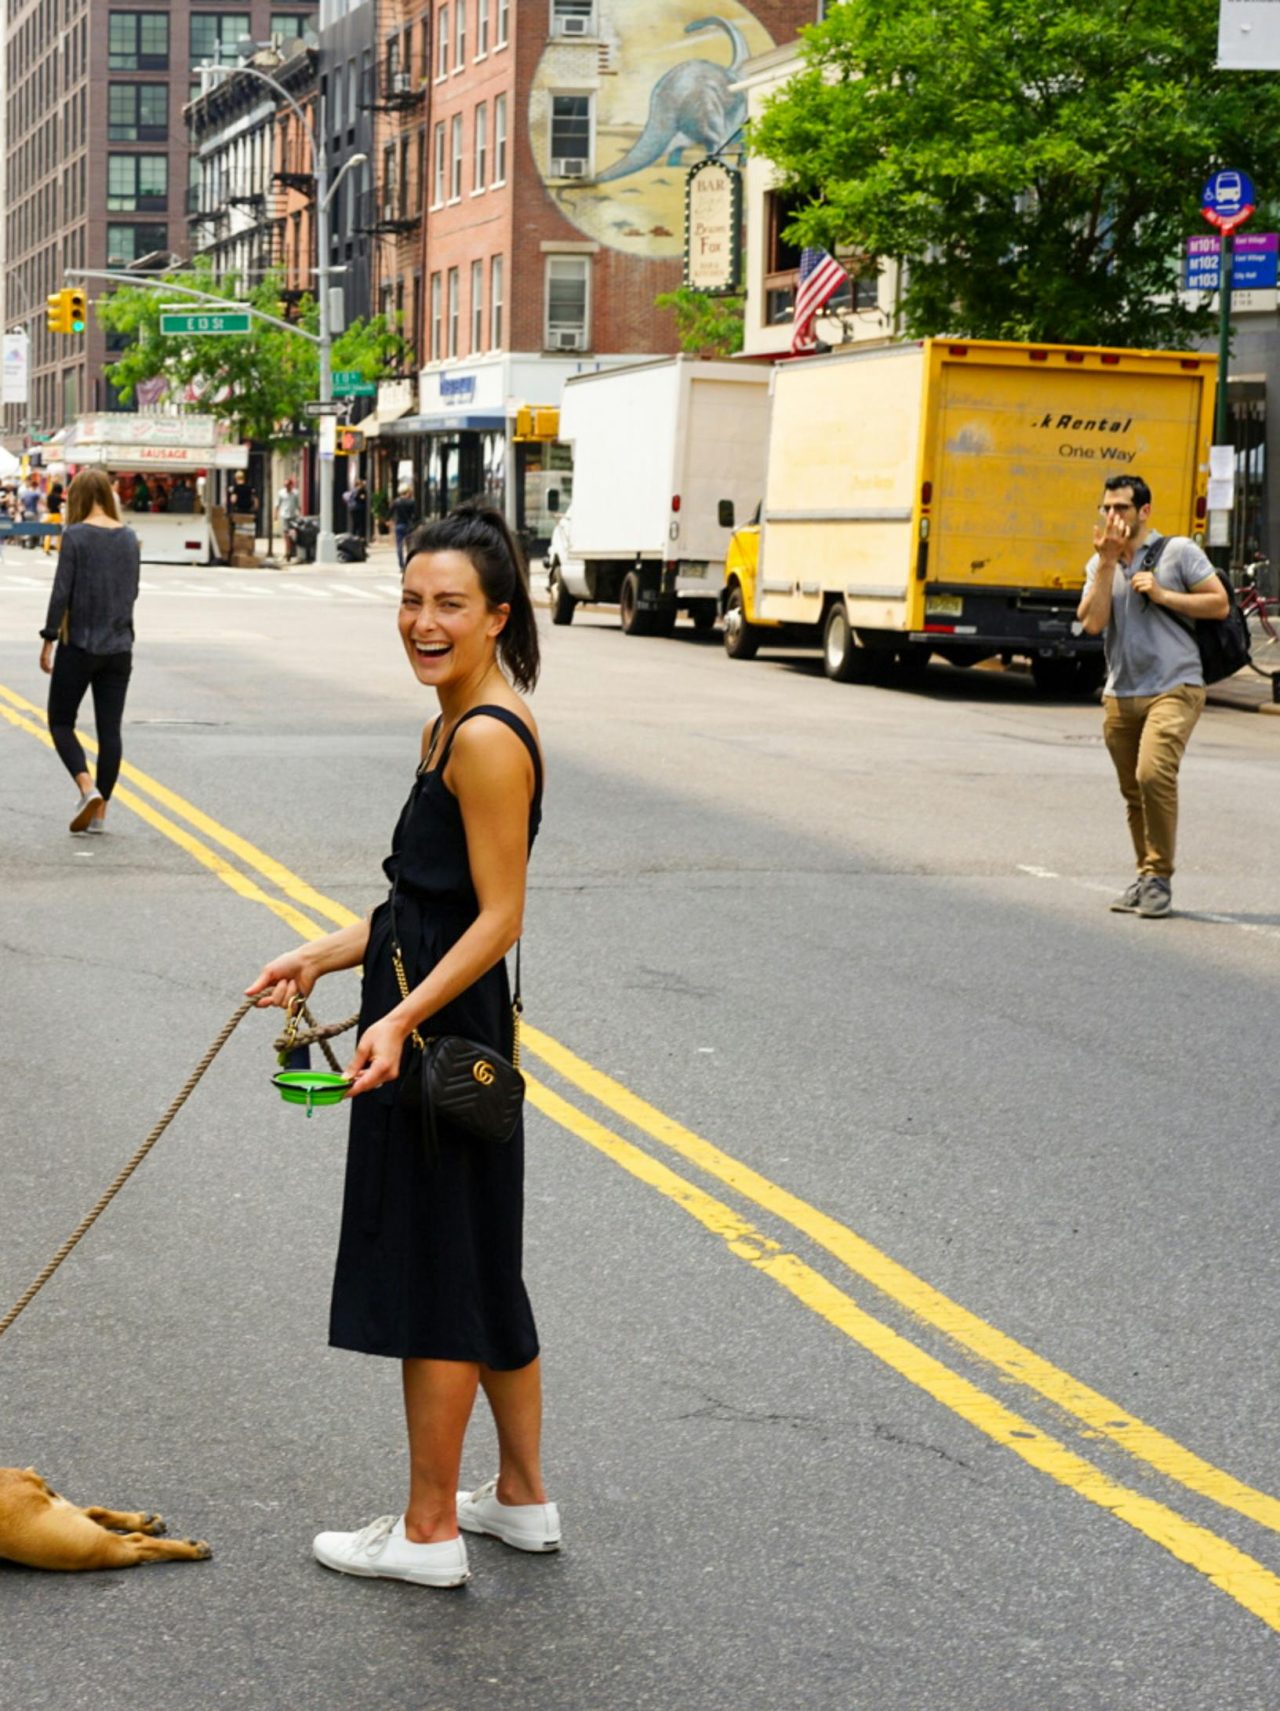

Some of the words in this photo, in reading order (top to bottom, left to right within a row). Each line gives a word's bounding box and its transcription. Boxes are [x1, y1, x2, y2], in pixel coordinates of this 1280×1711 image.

[697, 180, 725, 192] BAR
[1190, 238, 1216, 254] M101
[1189, 255, 1219, 269] M102
[1189, 272, 1218, 287] M103
[187, 318, 195, 330] E
[1056, 414, 1132, 433] Rental
[140, 449, 188, 459] SAUSAGE
[1058, 443, 1094, 458] One
[1101, 446, 1136, 463] Way
